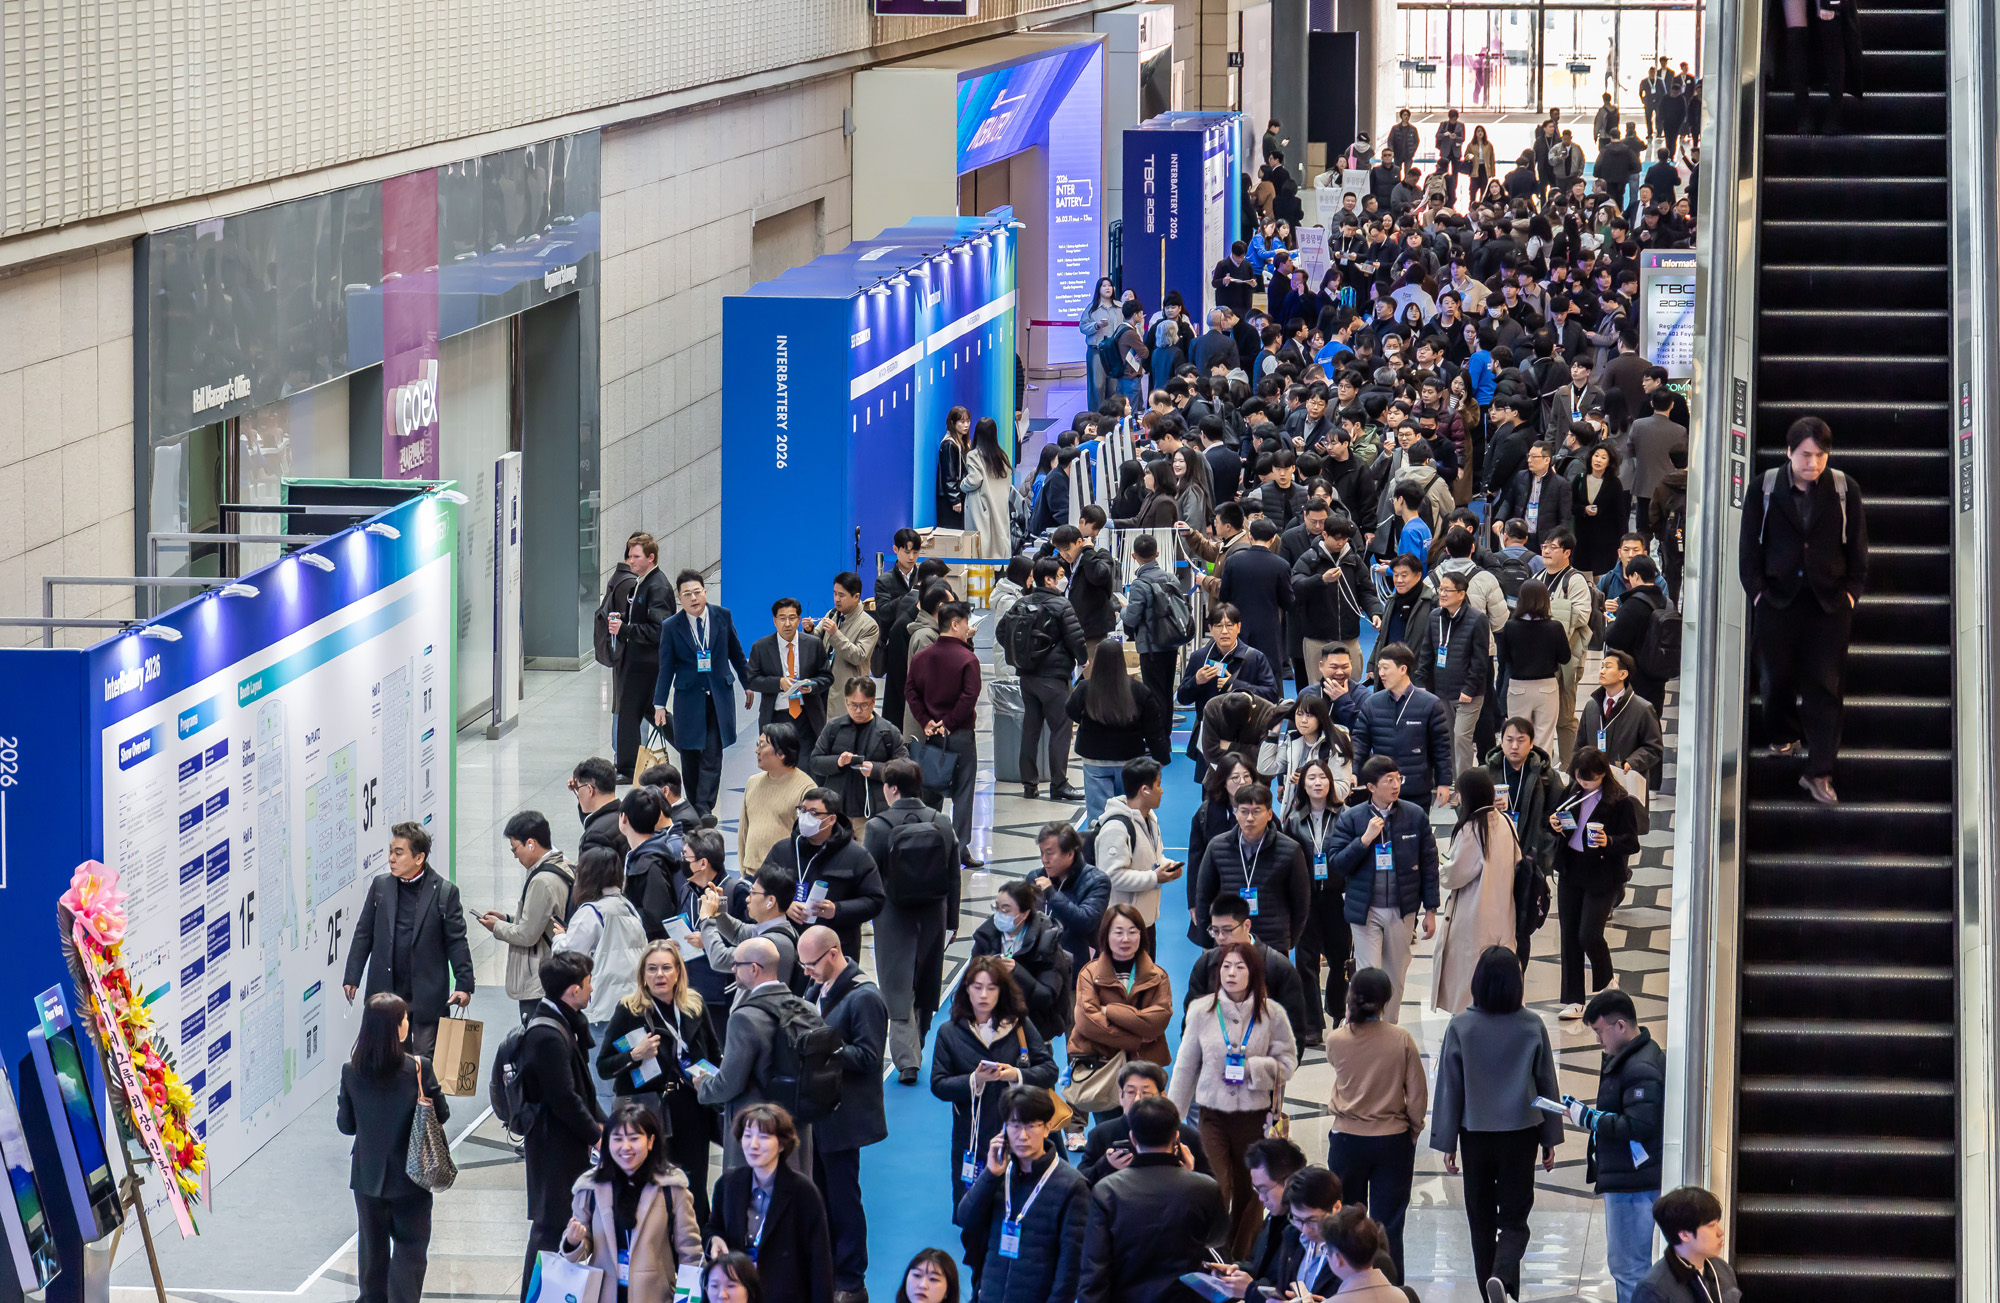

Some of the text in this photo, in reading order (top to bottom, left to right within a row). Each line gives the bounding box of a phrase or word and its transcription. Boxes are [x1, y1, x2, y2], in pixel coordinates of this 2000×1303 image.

[1056, 184, 1076, 196] INTER
[1056, 196, 1084, 208] BATTERY
[1144, 154, 1154, 234] TBC 2026
[1661, 258, 1697, 268] informatio
[1655, 284, 1695, 294] TBC
[193, 374, 251, 413] Hall Manager's Office
[396, 359, 438, 436] coex
[776, 335, 788, 469] INTERBATTERY 2026
[104, 654, 160, 702] InterBattery 2026
[250, 676, 262, 696] Layout
[180, 714, 198, 733] Programs
[0, 736, 18, 787] 2026
[120, 737, 151, 764] Show Overview
[363, 777, 377, 832] 3F
[240, 890, 254, 950] 1F
[327, 907, 342, 967] 2F
